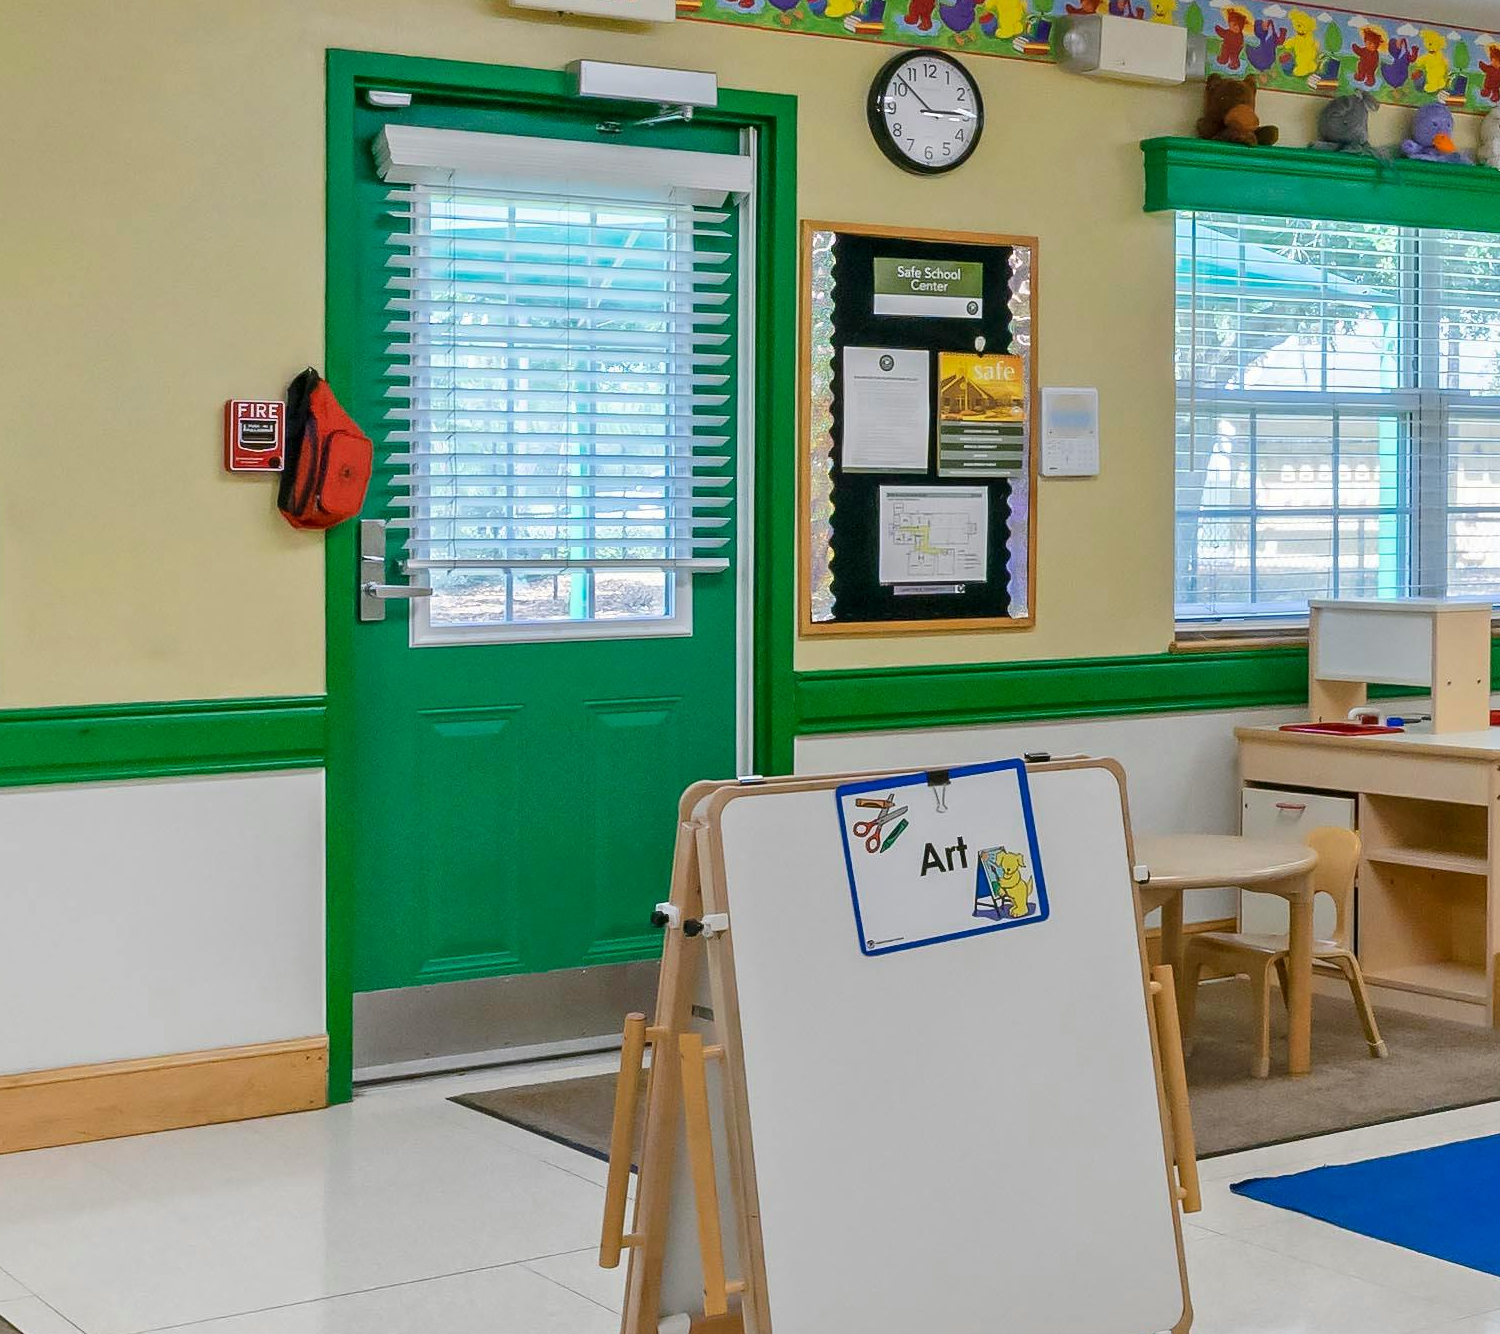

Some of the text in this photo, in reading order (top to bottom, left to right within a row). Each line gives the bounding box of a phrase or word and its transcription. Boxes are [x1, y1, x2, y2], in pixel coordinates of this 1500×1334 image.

[907, 67, 917, 82] 11
[923, 63, 937, 79] 12
[945, 70, 950, 85] 1
[892, 82, 908, 97] 10
[956, 87, 966, 102] 2
[892, 123, 902, 137] 8
[954, 128, 964, 142] 4
[906, 138, 915, 152] 7
[942, 142, 951, 156] 5
[924, 146, 933, 160] 6
[896, 265, 961, 280] Safe School
[910, 279, 949, 292] Center
[973, 360, 1016, 381] safe
[238, 403, 279, 419] FIRE
[920, 835, 969, 877] Art
